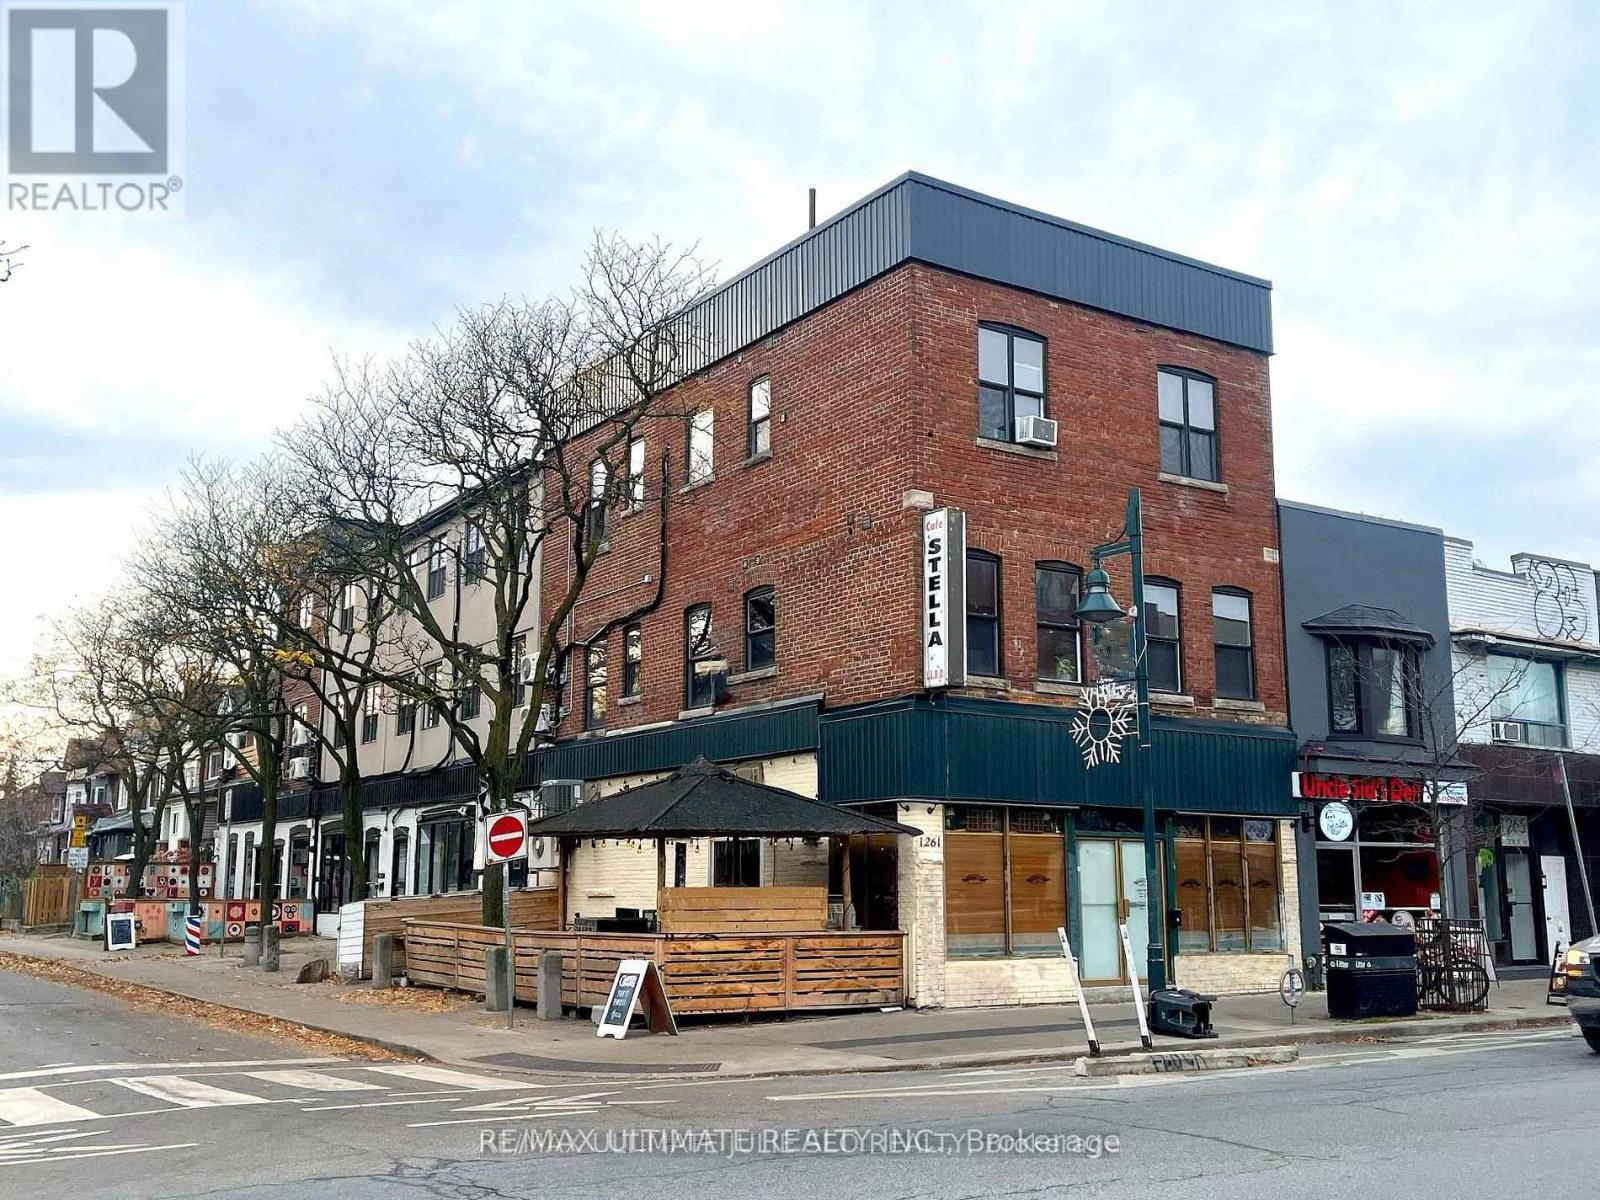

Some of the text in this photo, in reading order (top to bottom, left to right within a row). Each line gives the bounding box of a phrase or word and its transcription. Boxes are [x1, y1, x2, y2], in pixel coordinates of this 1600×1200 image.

[928, 538, 943, 648] STELLA
[1301, 772, 1350, 799] Uncle
[919, 836, 941, 848] 1261
